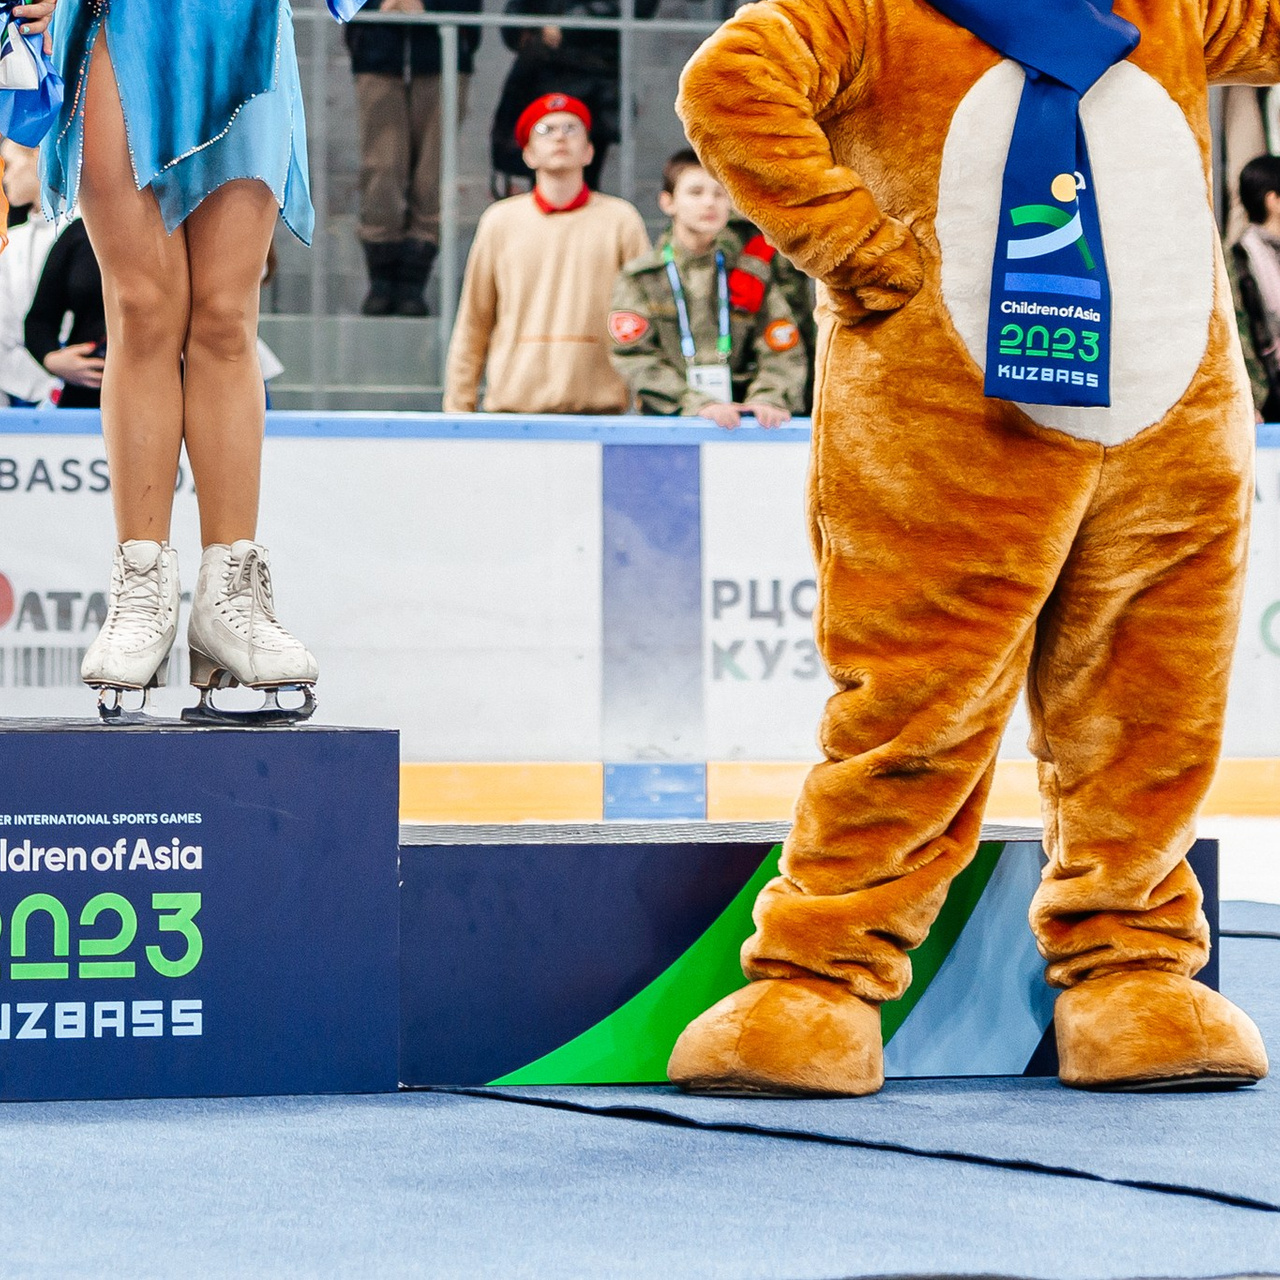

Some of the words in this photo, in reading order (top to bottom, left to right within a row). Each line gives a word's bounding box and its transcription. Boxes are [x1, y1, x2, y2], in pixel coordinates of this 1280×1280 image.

[1000, 300, 1058, 317] Children
[1058, 305, 1074, 318] of
[1074, 306, 1101, 322] Asia
[999, 323, 1100, 362] 2023
[998, 364, 1099, 388] KUZBASS
[711, 638, 821, 681] КУЗ
[14, 813, 110, 825] INTERNATIONAL
[112, 813, 158, 825] SPORTS
[160, 813, 202, 824] GAMES
[90, 837, 126, 871] of
[128, 837, 202, 870] Asia
